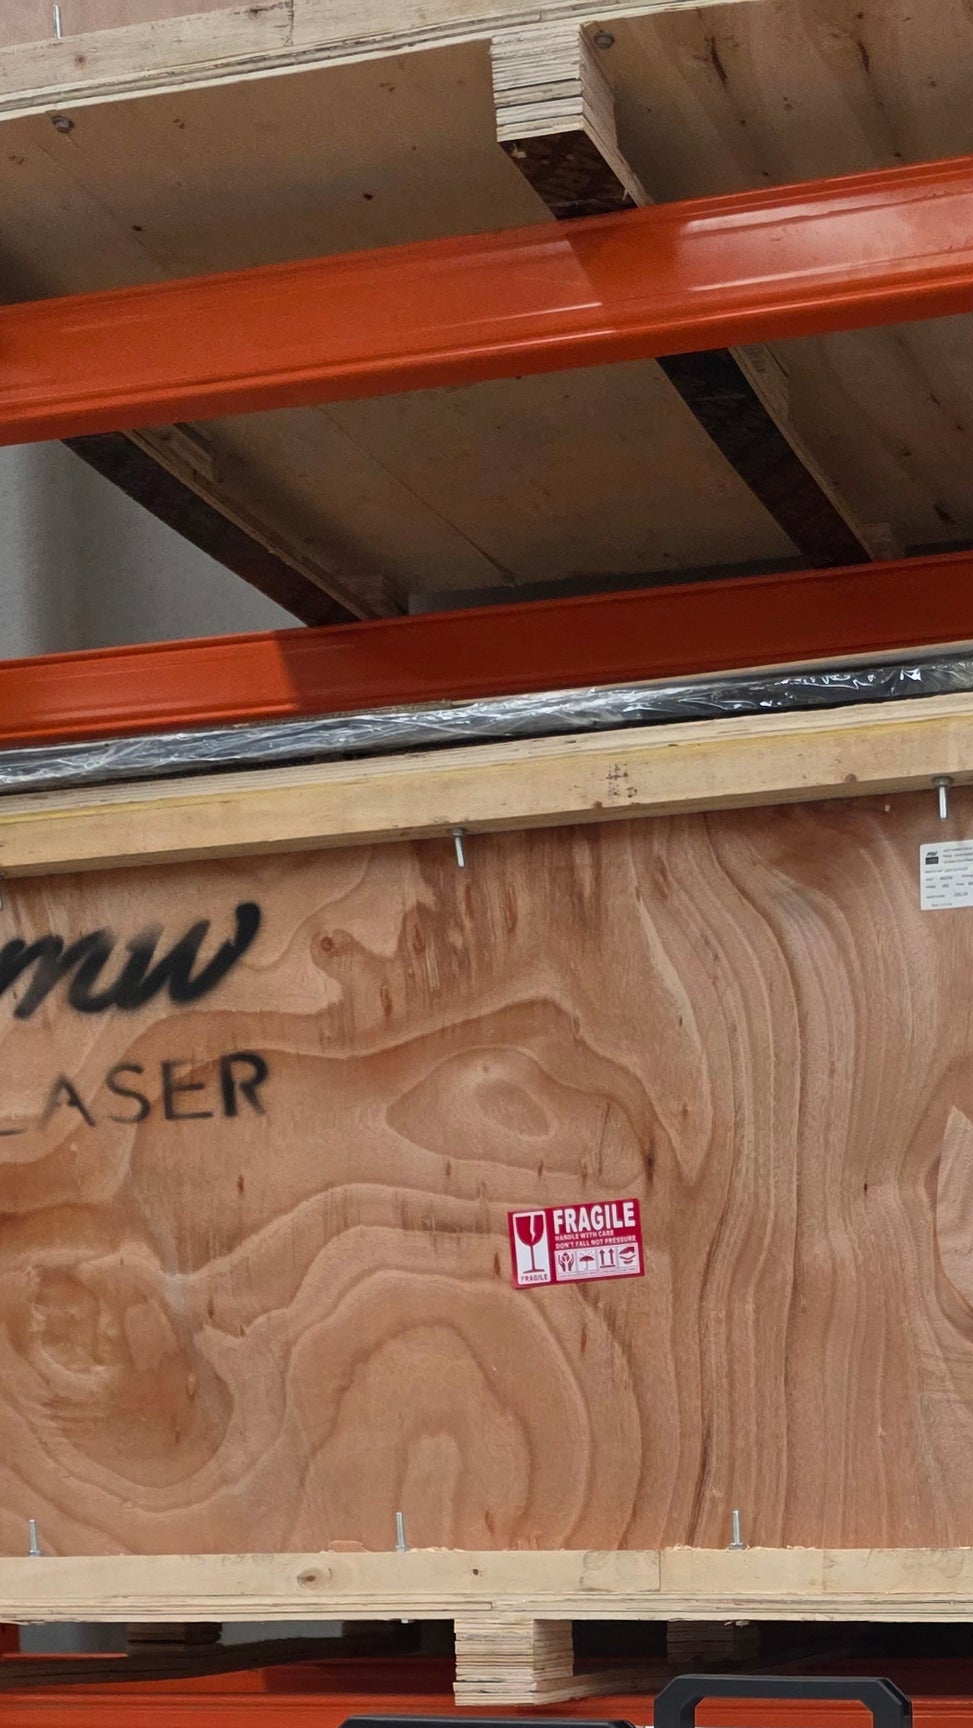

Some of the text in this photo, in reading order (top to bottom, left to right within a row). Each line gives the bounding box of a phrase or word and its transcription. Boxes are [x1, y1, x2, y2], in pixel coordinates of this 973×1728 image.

[0, 1052, 268, 1136] ASER
[553, 1202, 636, 1234] FRAGILE
[555, 1233, 579, 1241] HANDLE
[580, 1231, 597, 1239] WITH
[555, 1235, 636, 1249] DON'T FALL NOT PRESSURE
[520, 1273, 548, 1282] FRAGILE
